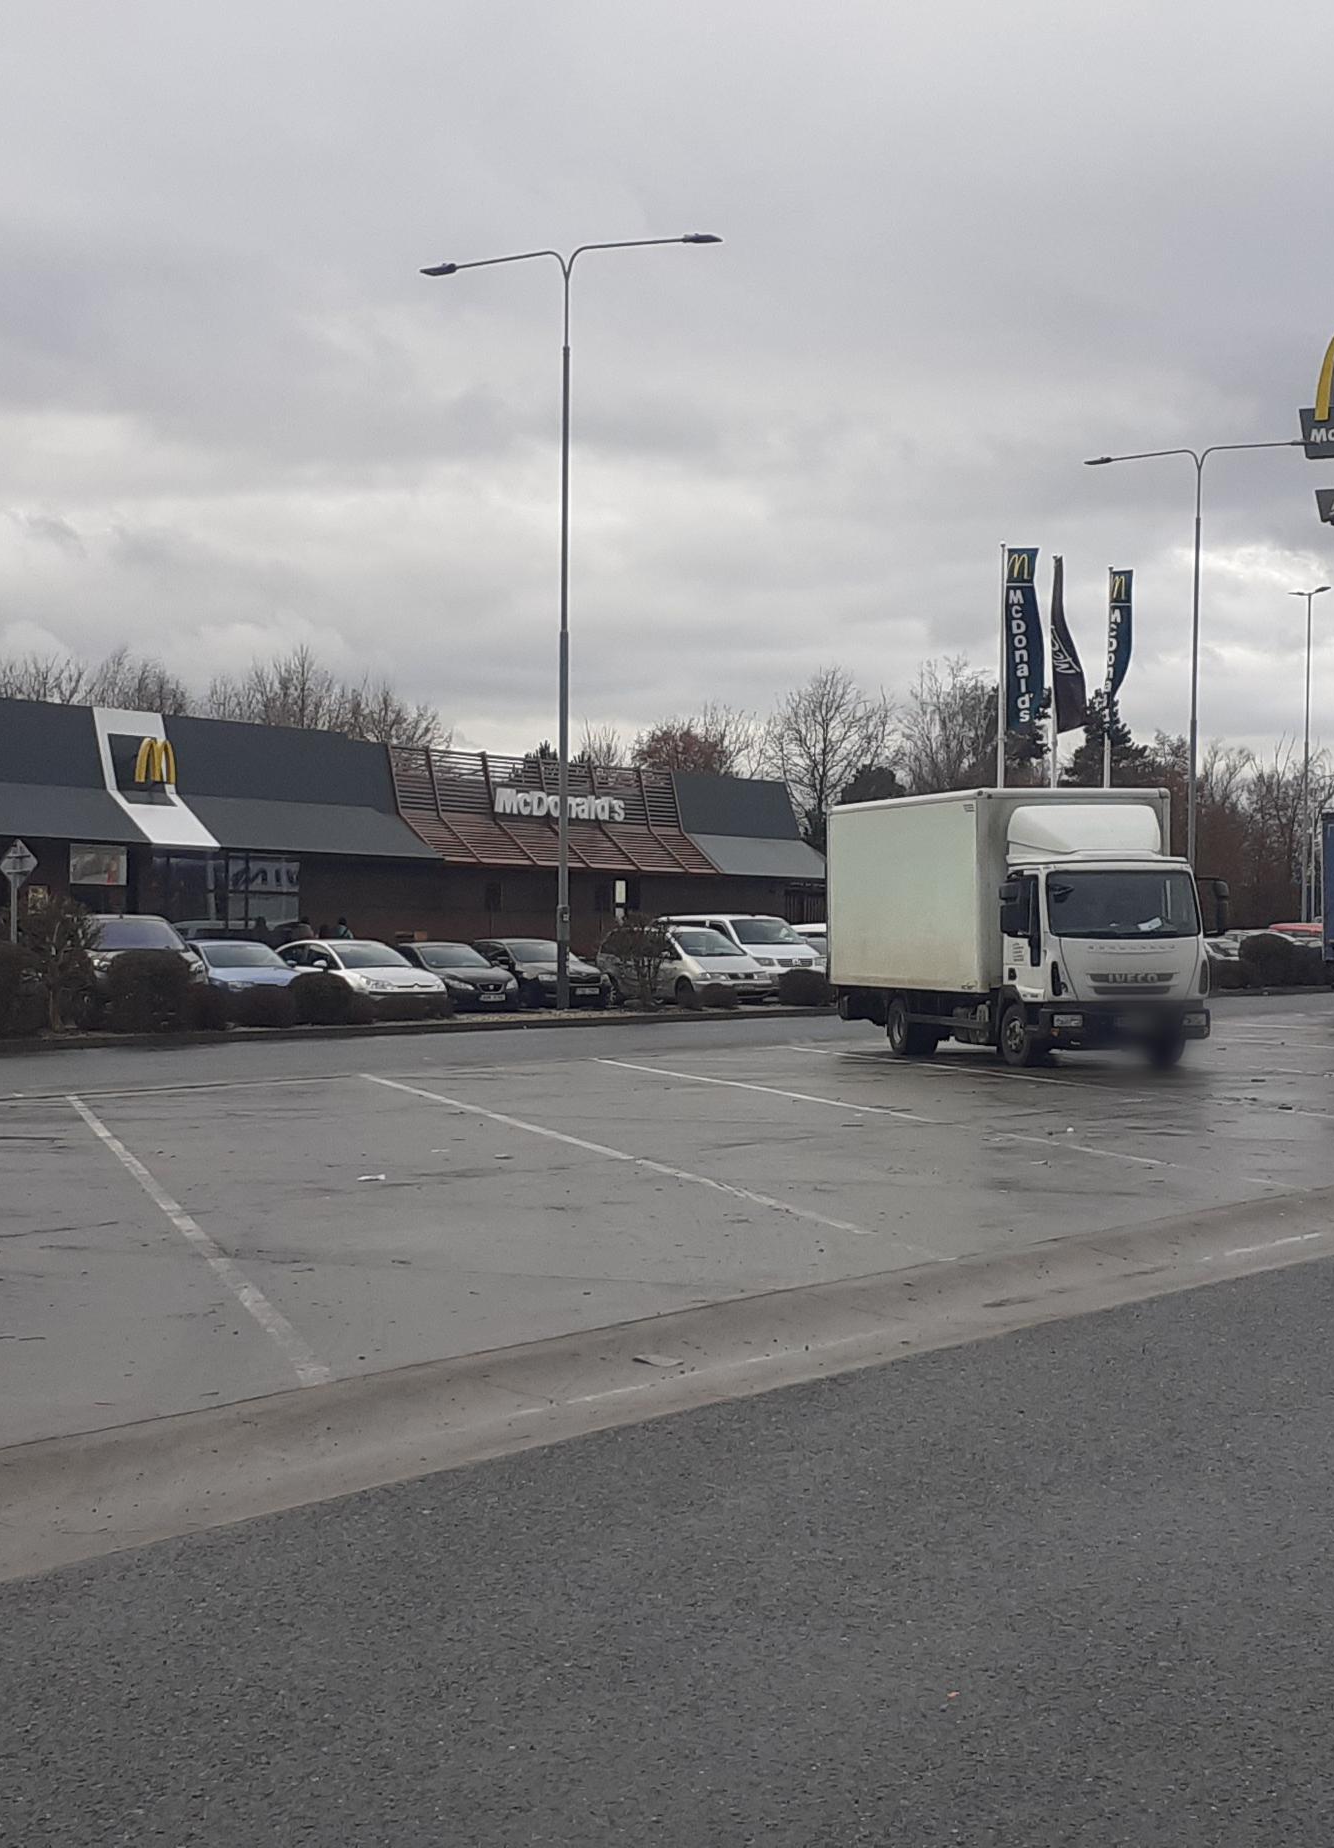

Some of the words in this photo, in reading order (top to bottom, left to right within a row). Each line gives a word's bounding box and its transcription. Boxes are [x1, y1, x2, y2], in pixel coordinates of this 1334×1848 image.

[1008, 589, 1034, 723] McDonald's
[494, 787, 626, 822] McDonald's
[1108, 973, 1159, 985] IVECO
